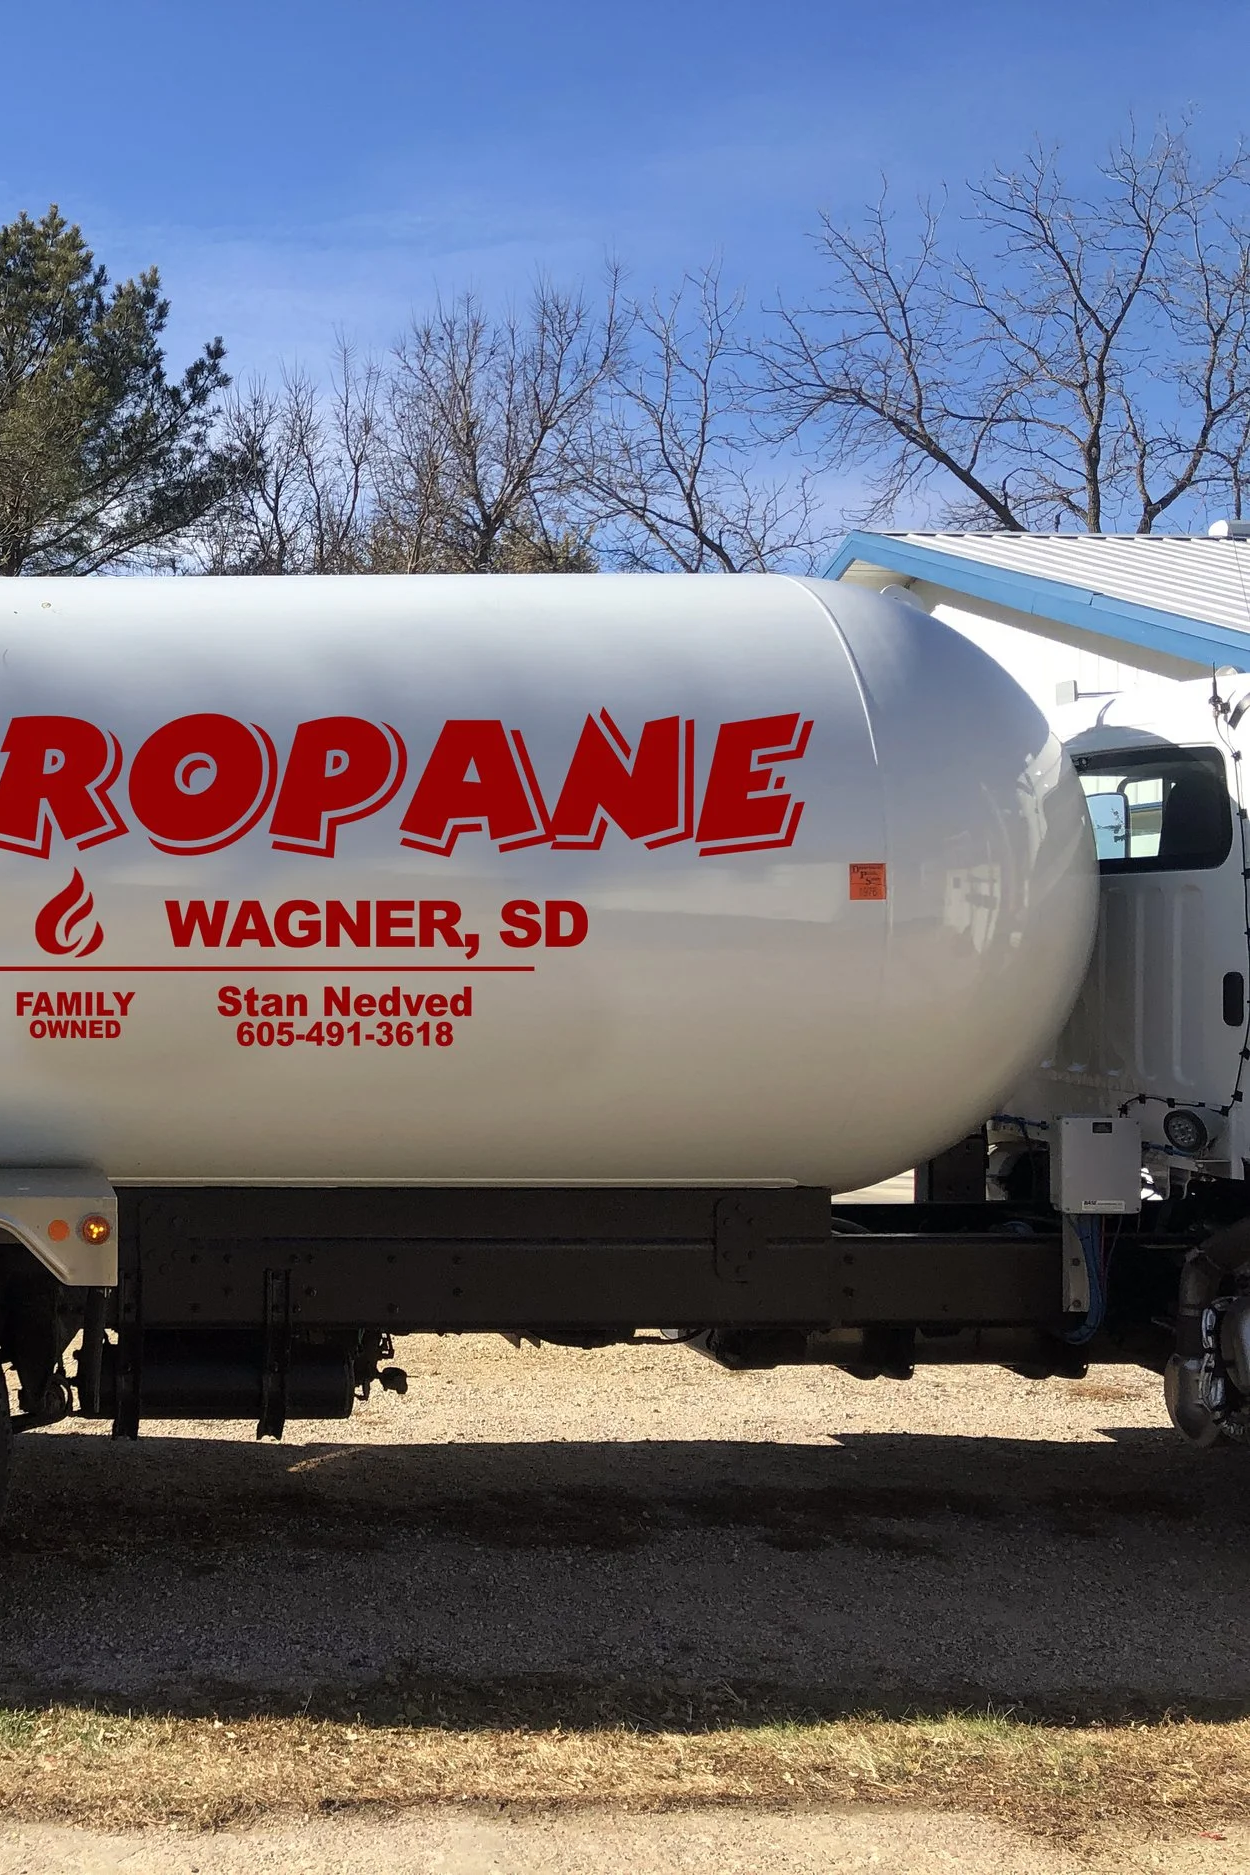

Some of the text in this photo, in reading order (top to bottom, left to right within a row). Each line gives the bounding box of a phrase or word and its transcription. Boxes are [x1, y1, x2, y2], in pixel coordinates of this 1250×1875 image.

[165, 899, 588, 960] WAGNER, SD
[16, 992, 135, 1017] FAMILY
[218, 986, 472, 1017] Stan Nedved
[29, 1020, 121, 1039] OWNED
[237, 1021, 453, 1047] 605-491-3618
